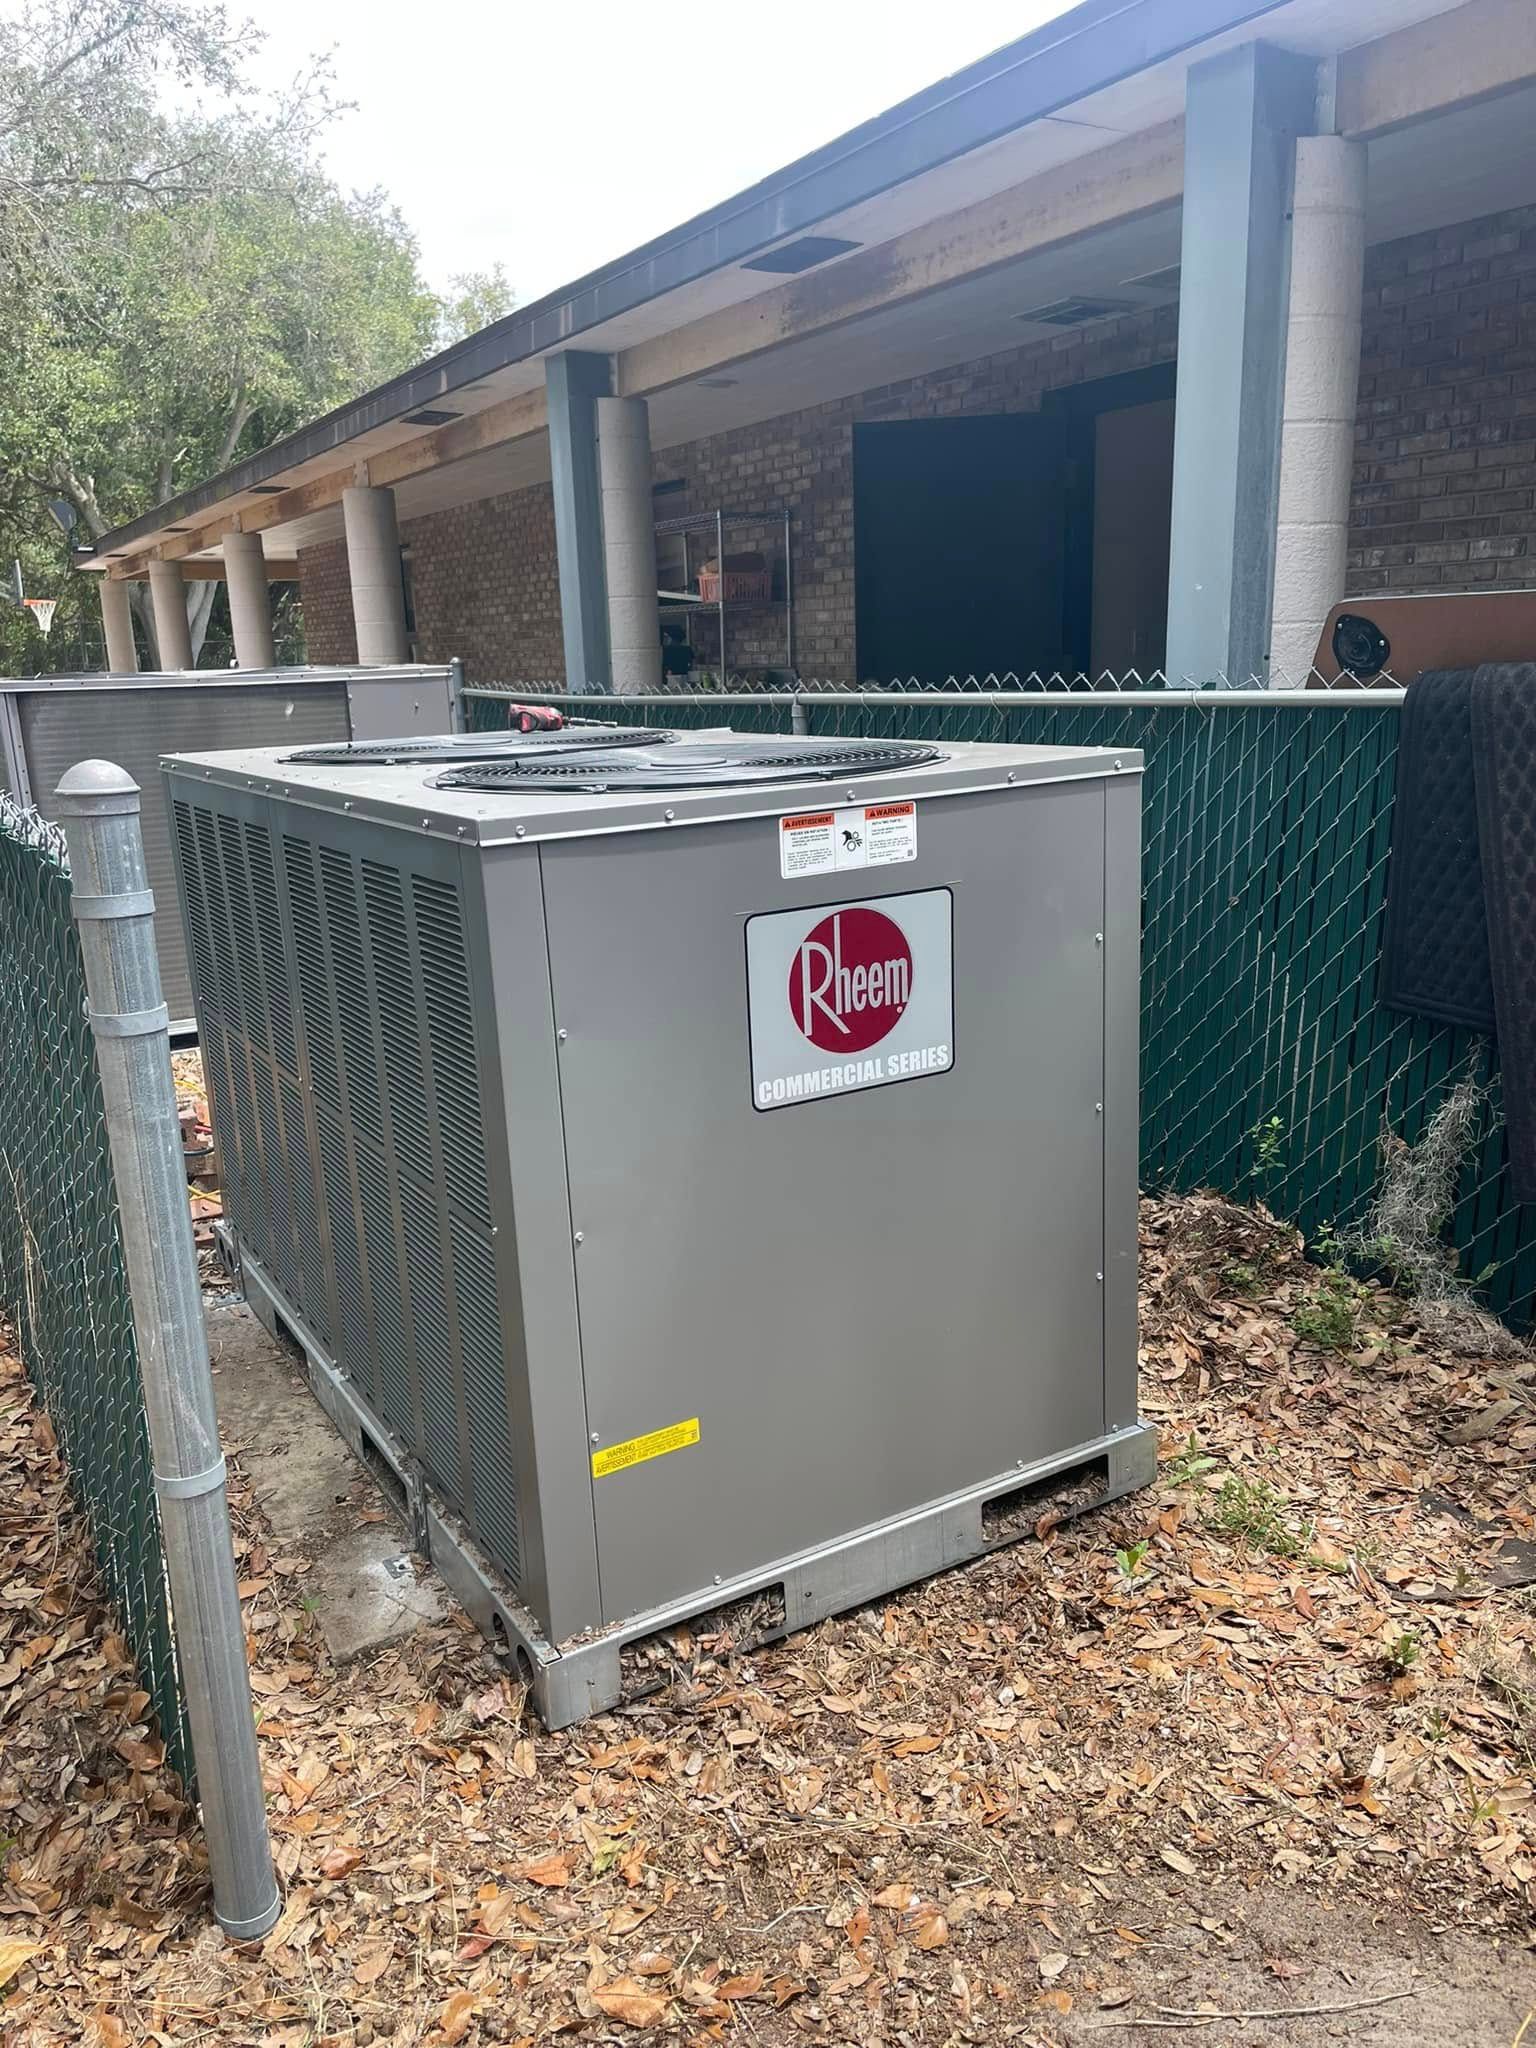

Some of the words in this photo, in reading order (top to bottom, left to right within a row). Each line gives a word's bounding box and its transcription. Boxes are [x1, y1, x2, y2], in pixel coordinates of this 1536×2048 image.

[875, 805, 910, 817] WARNING
[791, 815, 832, 827] AVERTISSEMENT
[801, 914, 910, 1036] Rheem
[758, 1057, 885, 1103] COMMERCIAL
[887, 1045, 949, 1076] SERIES
[606, 1443, 635, 1458] WARNING
[596, 1453, 637, 1474] AVERTISSEMENT
